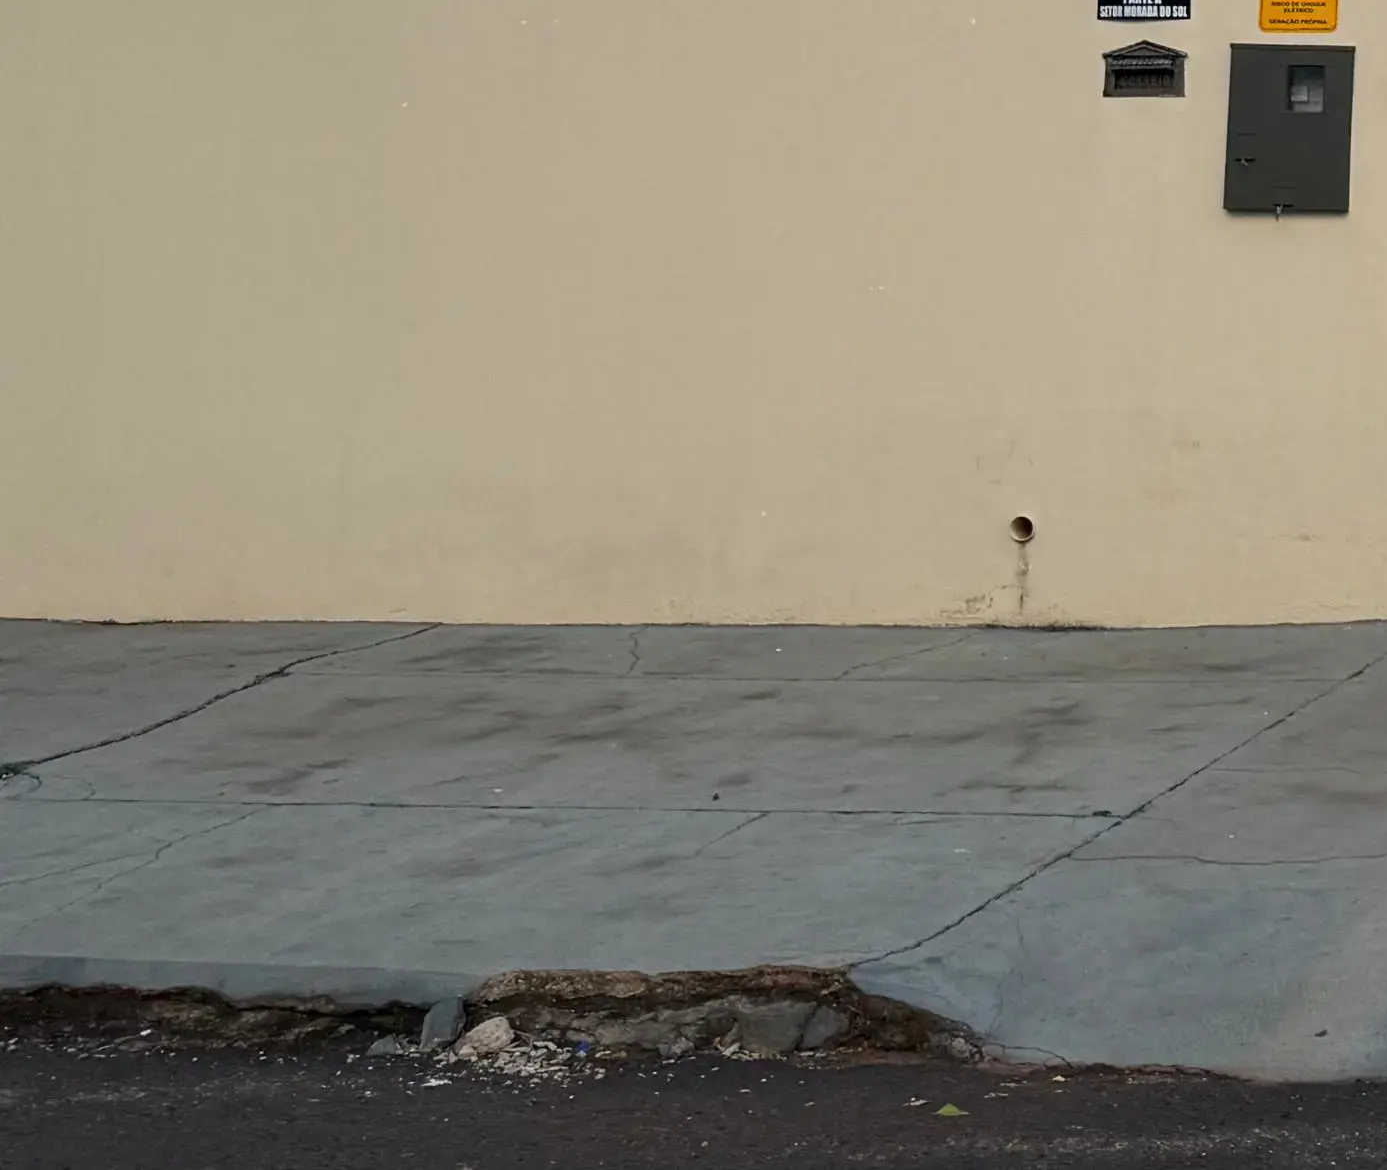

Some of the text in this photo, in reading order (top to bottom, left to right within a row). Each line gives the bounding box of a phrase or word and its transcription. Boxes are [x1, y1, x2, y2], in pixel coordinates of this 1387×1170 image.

[1099, 6, 1188, 18] SETOR MORADA DO SOL
